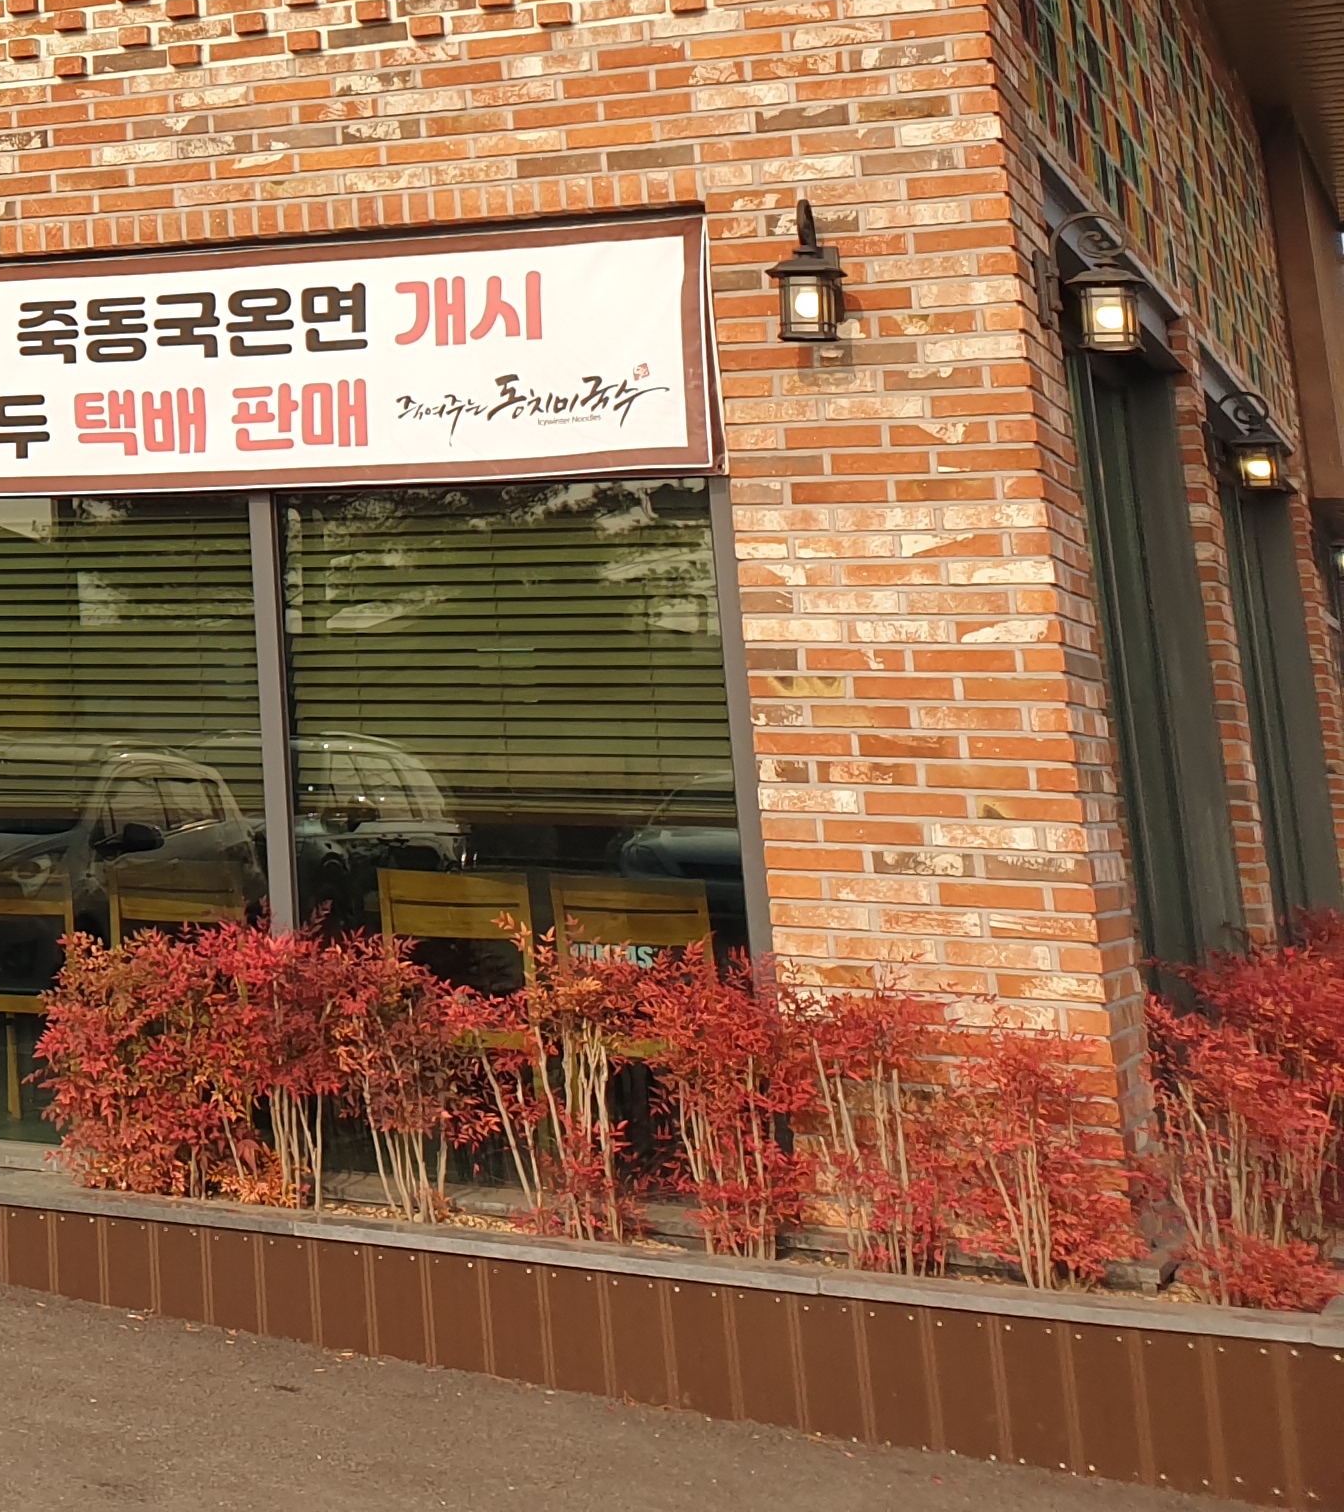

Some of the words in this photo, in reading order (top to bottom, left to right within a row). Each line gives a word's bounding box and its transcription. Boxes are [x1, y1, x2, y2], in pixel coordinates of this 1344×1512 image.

[16, 281, 369, 364] 죽동국온면
[394, 270, 543, 347] 개시
[73, 386, 207, 457] 택배
[231, 377, 369, 452] 판매
[395, 393, 488, 448] 죽여주는
[486, 373, 670, 429] 동치미국수
